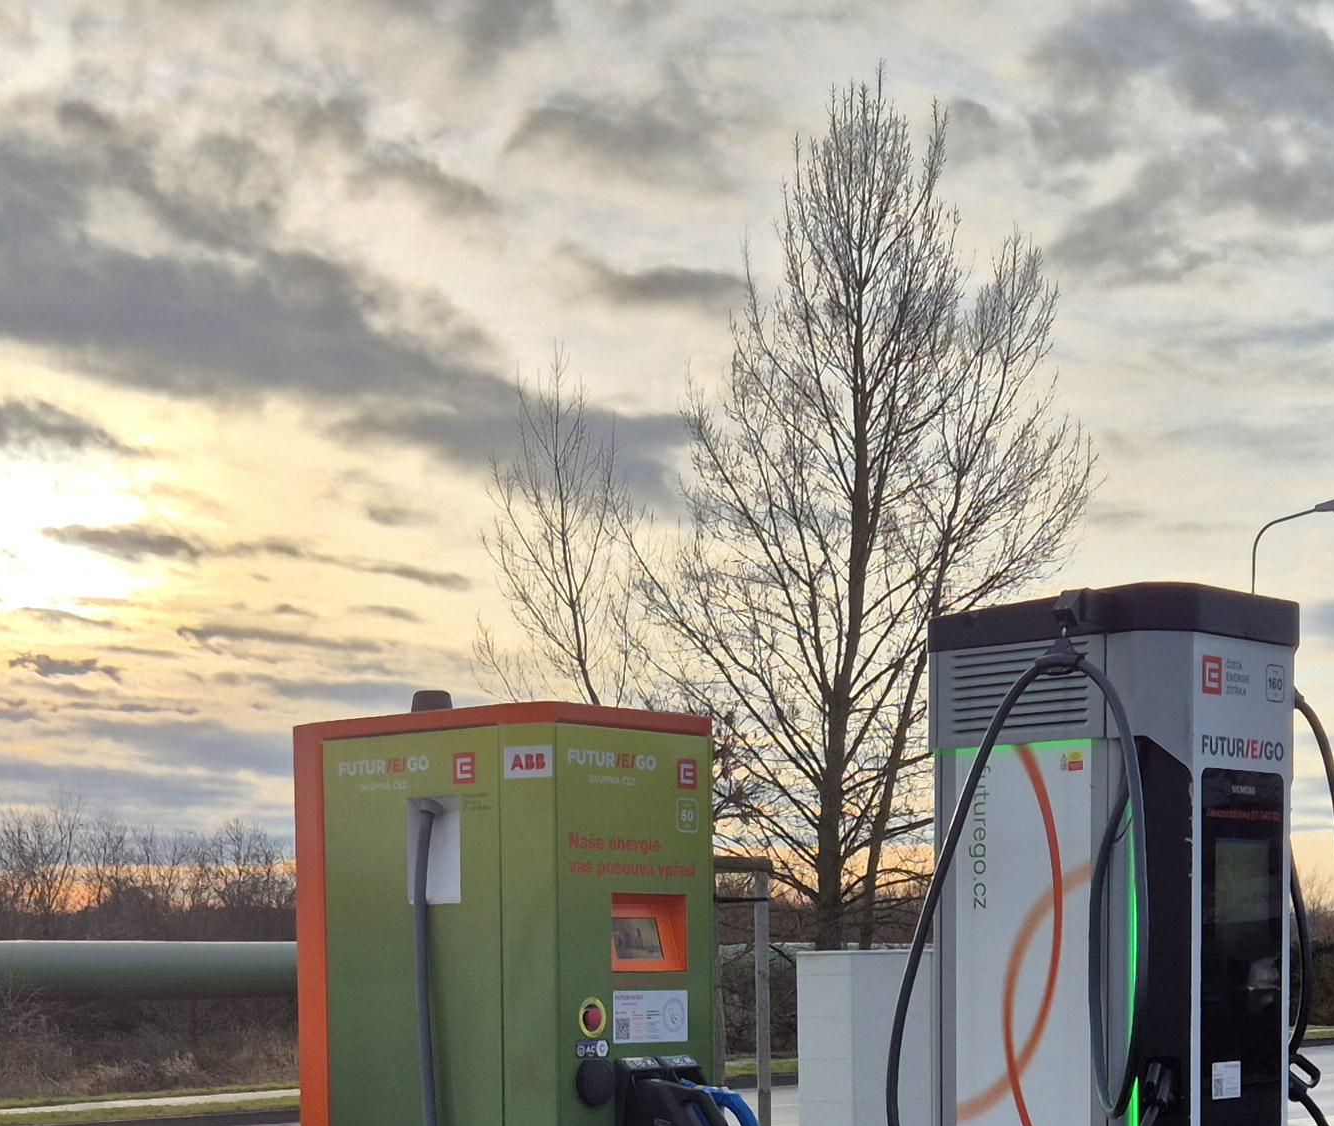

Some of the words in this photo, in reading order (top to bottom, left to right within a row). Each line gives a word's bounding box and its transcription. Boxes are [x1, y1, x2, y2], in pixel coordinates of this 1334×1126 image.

[1268, 677, 1283, 690] 160
[1201, 734, 1284, 761] FUTUR/E/GO
[338, 753, 430, 778] FUTUR/E/GO
[510, 753, 546, 771] ABB
[567, 748, 656, 770] FUTUR/E/GO
[1231, 785, 1256, 795] SIEMENS
[680, 809, 694, 822] 50
[569, 831, 604, 850] Naše
[609, 837, 662, 855] energie
[597, 861, 655, 879] posouvá
